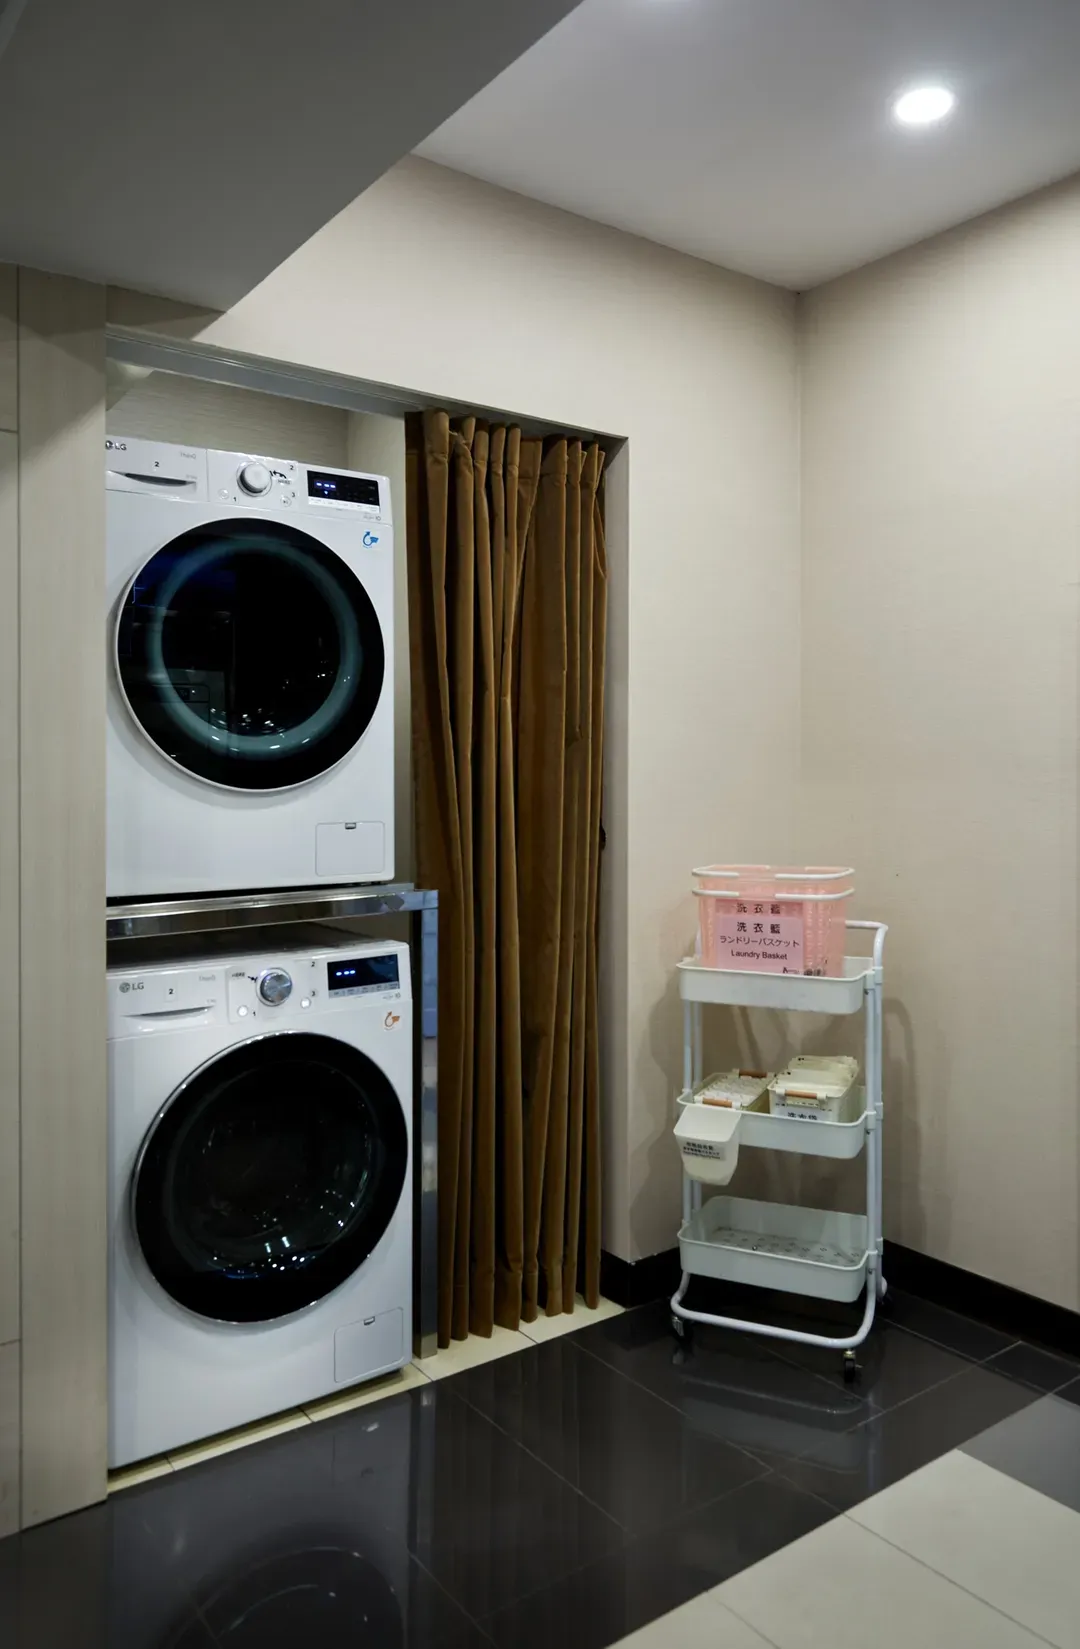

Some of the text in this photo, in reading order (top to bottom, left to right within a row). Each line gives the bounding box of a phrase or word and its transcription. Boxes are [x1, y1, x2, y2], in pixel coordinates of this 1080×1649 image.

[115, 442, 127, 451] LG
[731, 949, 788, 960] Laundry Basket
[131, 982, 144, 991] LG
